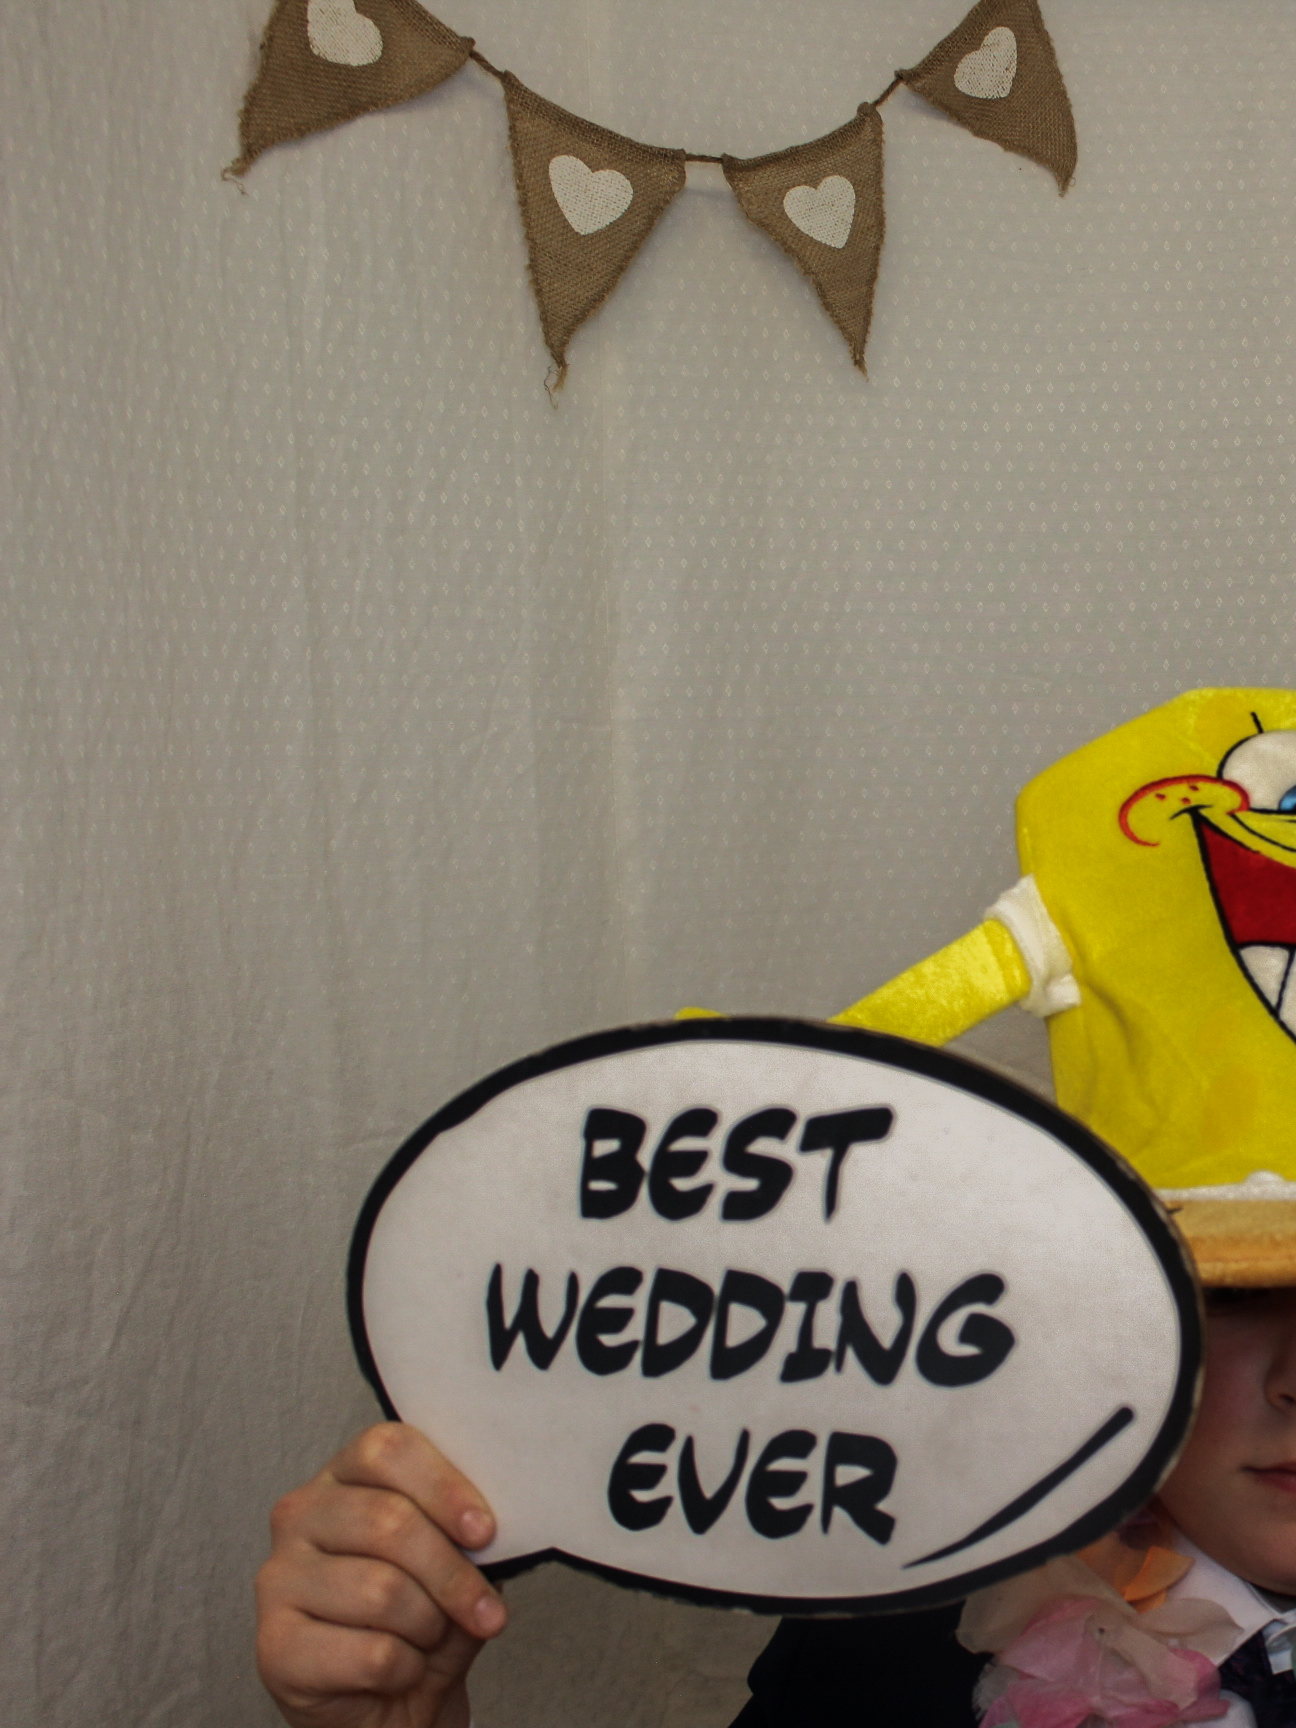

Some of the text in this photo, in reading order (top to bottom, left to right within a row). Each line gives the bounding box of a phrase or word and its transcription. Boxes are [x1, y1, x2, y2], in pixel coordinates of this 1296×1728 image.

[579, 1106, 895, 1222] BEST
[485, 1263, 1016, 1388] WEDDING
[606, 1422, 899, 1547] EVER
